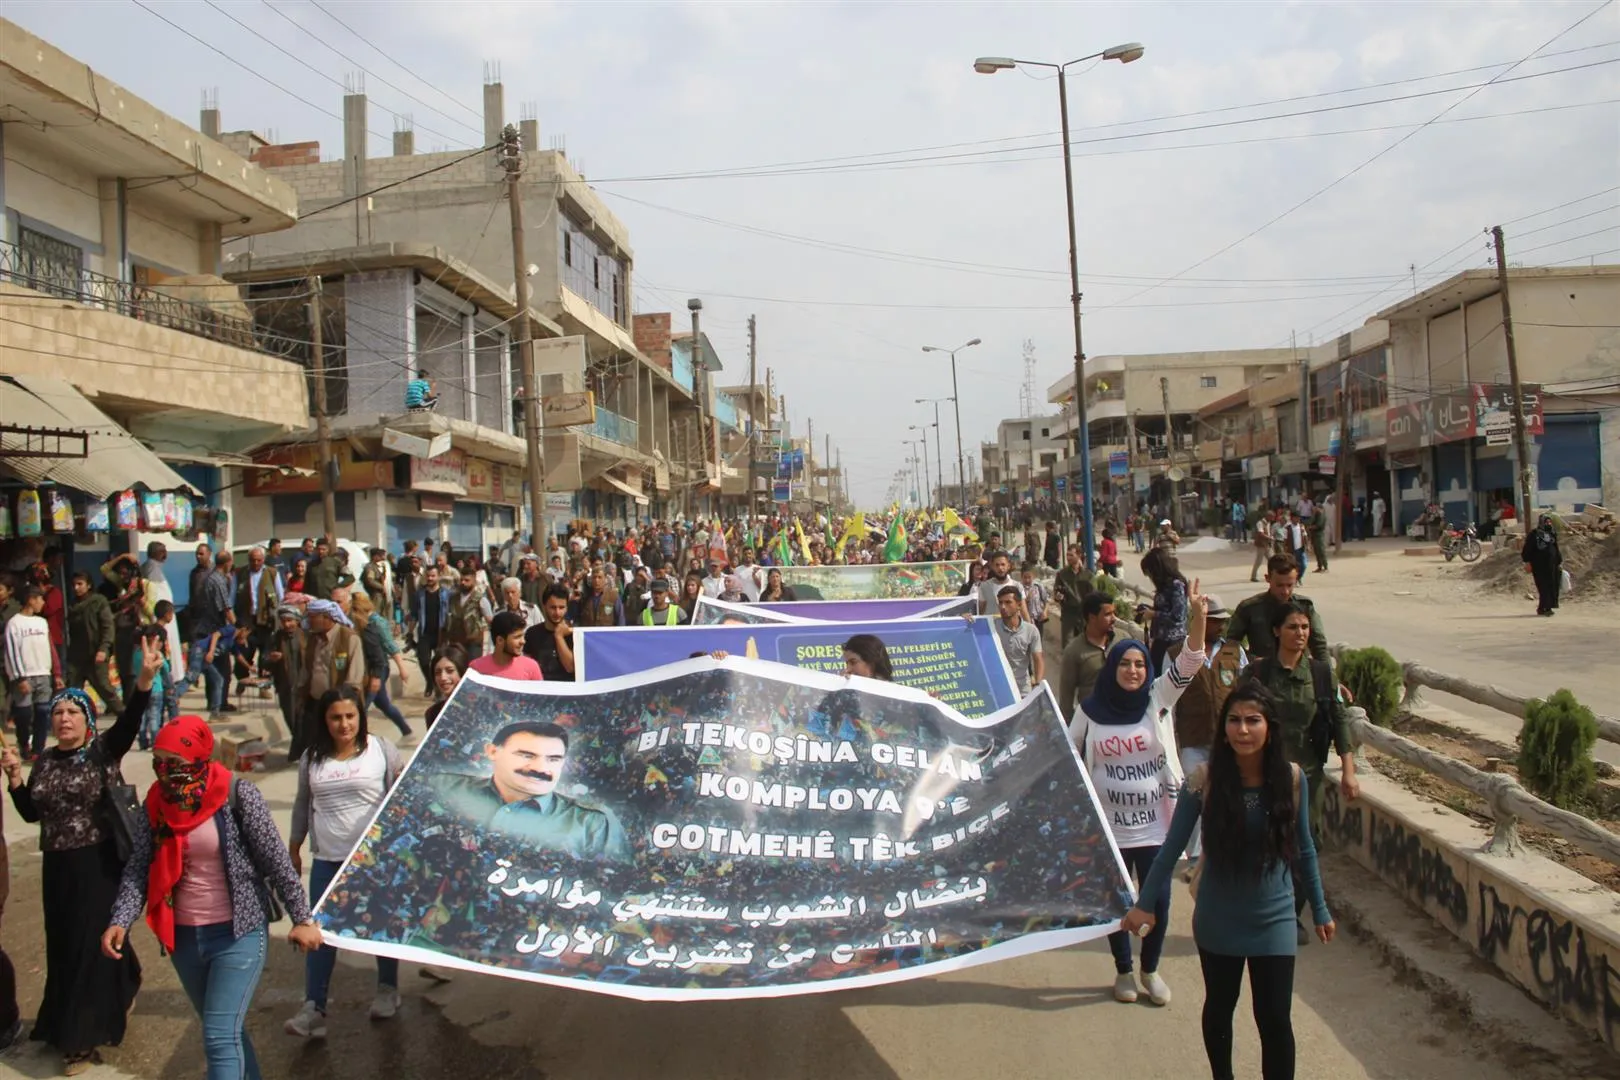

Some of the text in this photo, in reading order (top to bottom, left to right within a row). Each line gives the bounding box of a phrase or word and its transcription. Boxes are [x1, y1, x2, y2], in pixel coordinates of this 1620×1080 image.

[638, 726, 671, 752] BI
[682, 722, 858, 765] TEKOŞÎNA
[871, 742, 983, 781] GELAN
[700, 772, 902, 814] KOMPLOYA
[1107, 788, 1147, 806] WITH
[1114, 809, 1157, 827] ALARM
[652, 823, 835, 859] COTMEHÊ
[849, 832, 921, 861] TÊK
[611, 894, 729, 922] ستنتهي
[741, 895, 867, 928] الشعوب
[883, 876, 988, 918] بنضال
[627, 938, 753, 969] تشرين
[766, 943, 816, 969] من
[831, 927, 937, 964] التاسع
